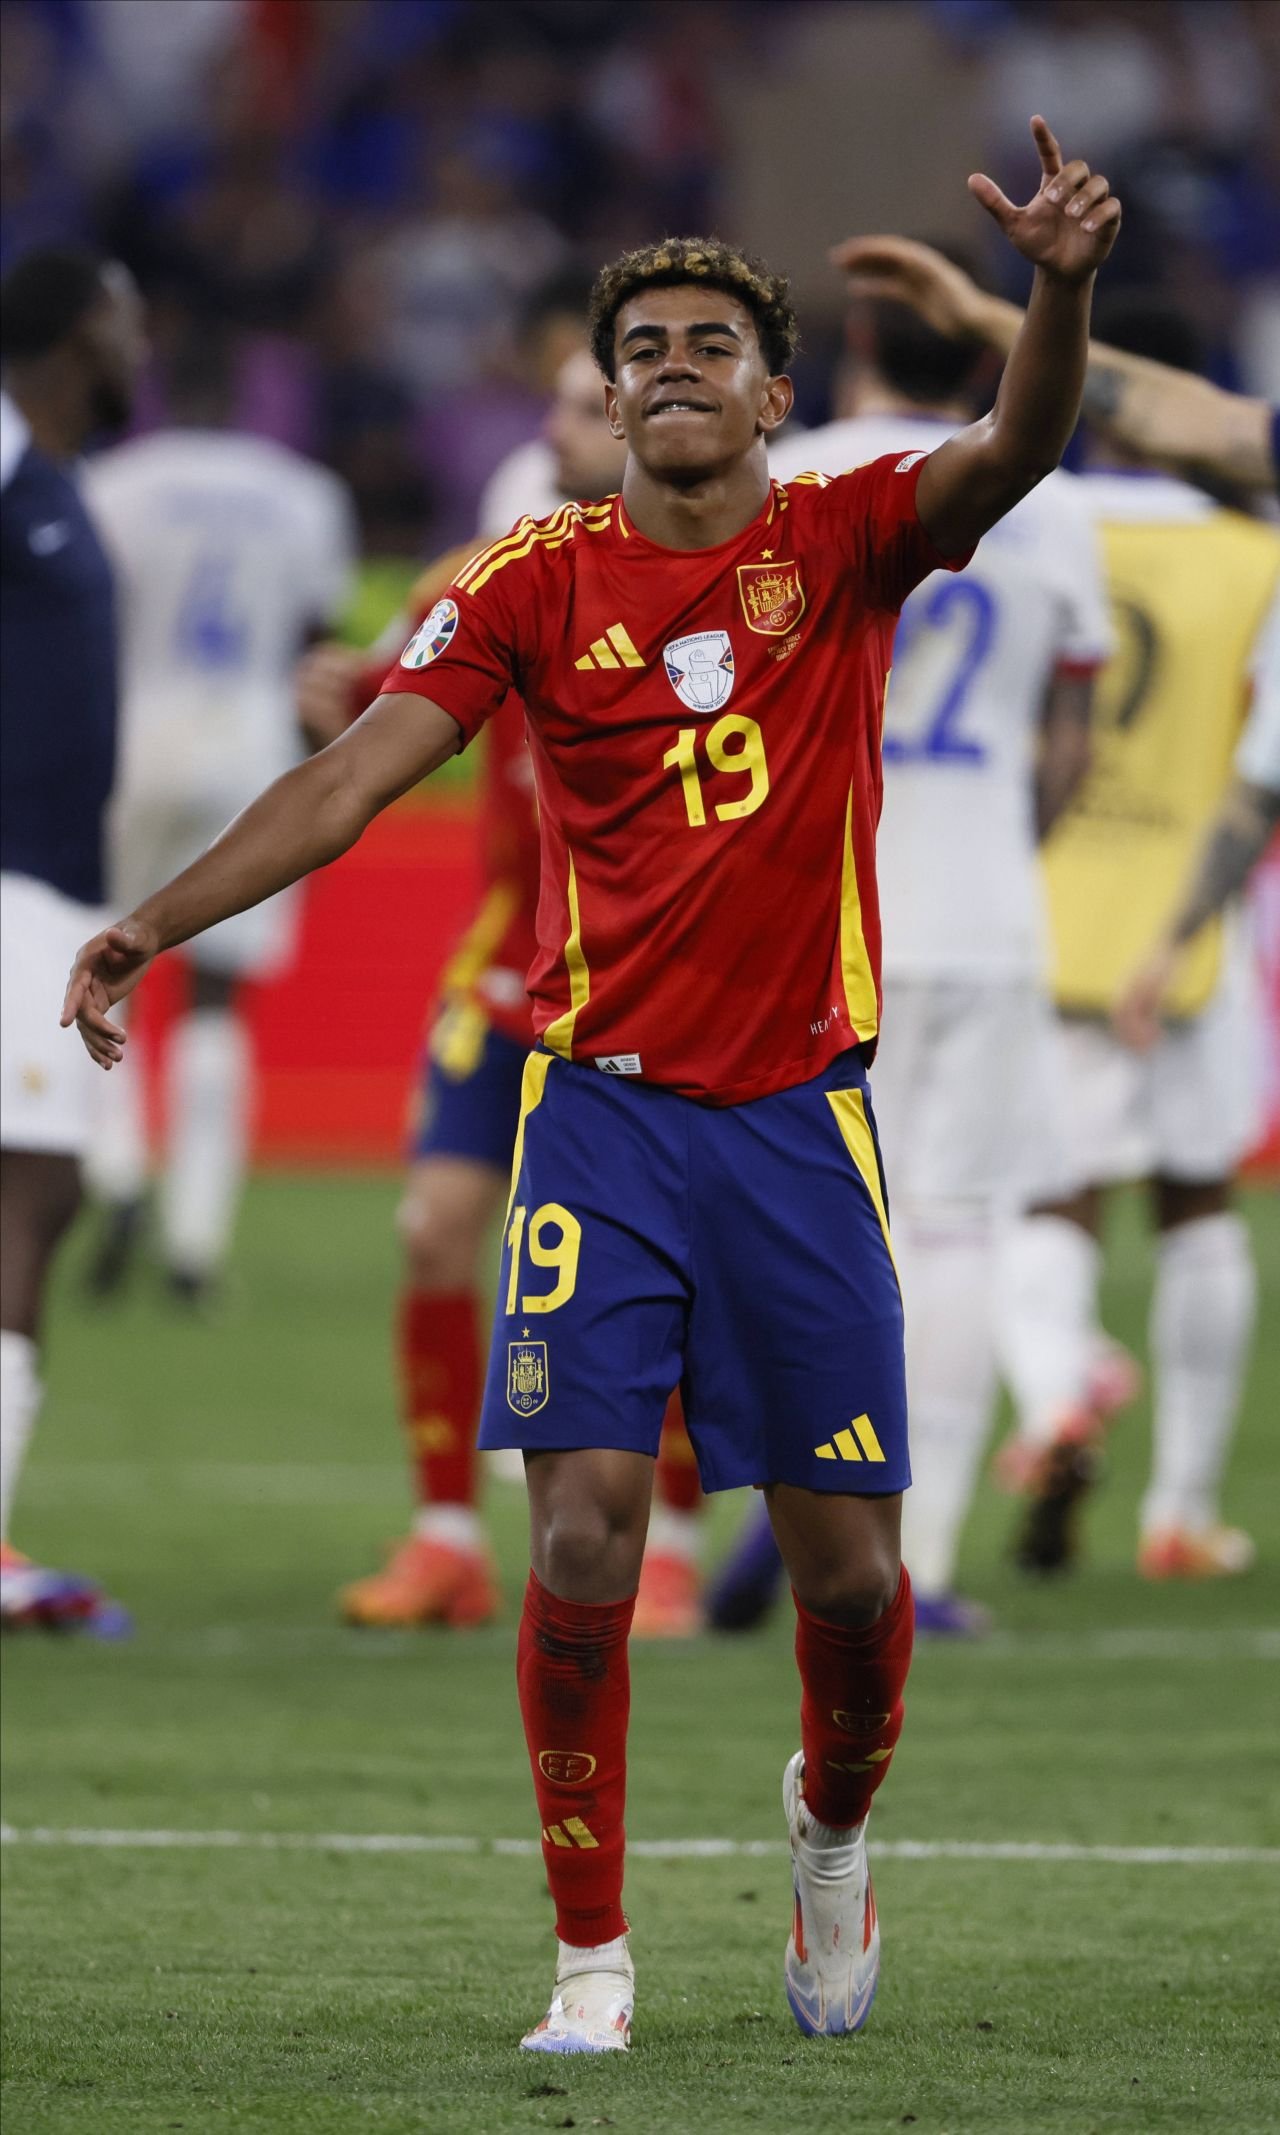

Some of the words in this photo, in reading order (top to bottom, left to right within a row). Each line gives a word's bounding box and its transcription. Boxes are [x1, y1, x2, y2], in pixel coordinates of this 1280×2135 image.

[882, 577, 995, 764] 2
[663, 713, 770, 827] 19
[505, 1202, 582, 1315] 19
